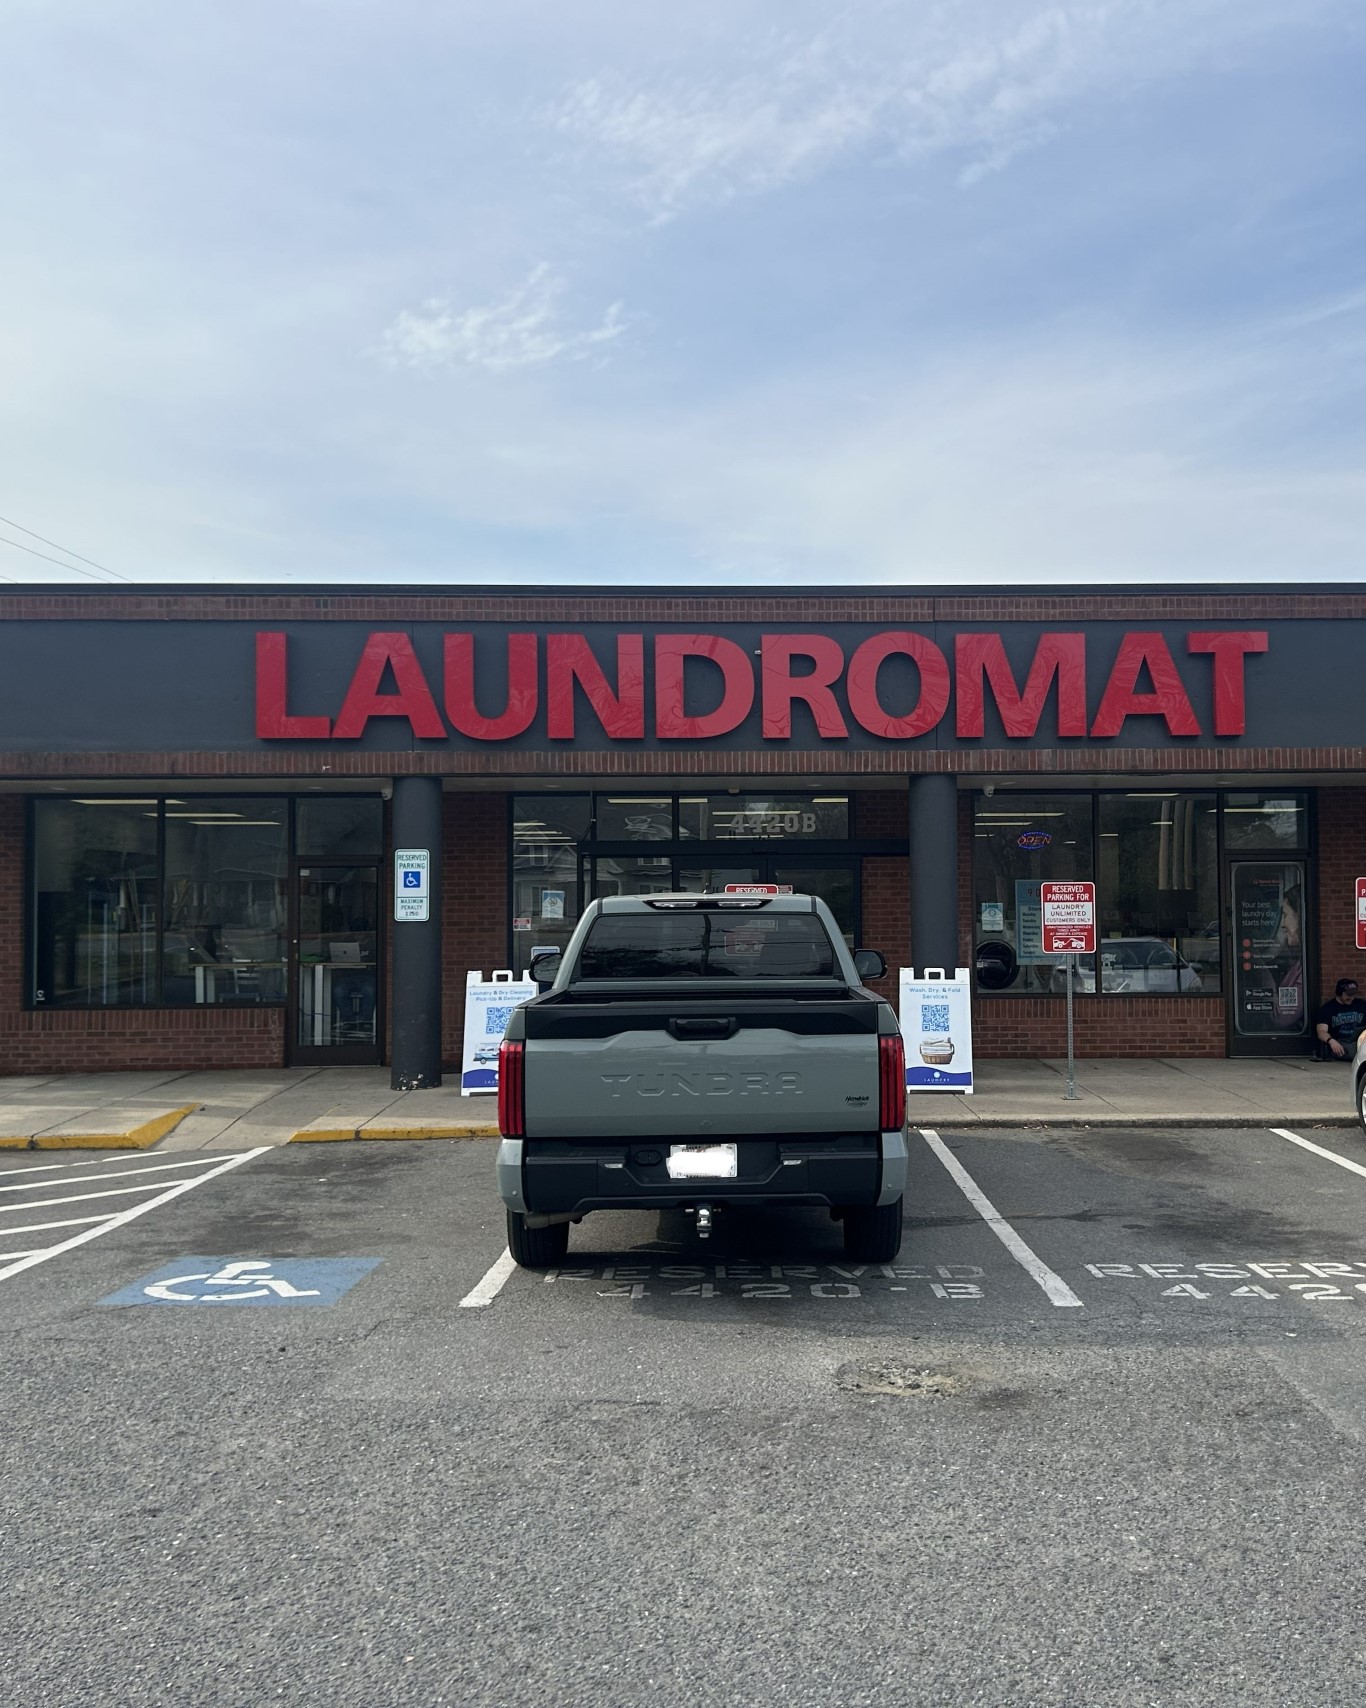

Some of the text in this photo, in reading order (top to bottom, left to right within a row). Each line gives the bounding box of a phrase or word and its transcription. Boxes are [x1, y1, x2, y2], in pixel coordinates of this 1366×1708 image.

[255, 631, 1270, 740] LAUNDROMAT
[730, 812, 816, 833] 4420B
[1017, 835, 1051, 845] OPEN
[1051, 885, 1084, 893] RESERVED
[1047, 893, 1074, 901] PARKING
[1242, 910, 1277, 918] laundry day
[600, 1072, 803, 1097] TUNDRA
[543, 1264, 985, 1283] RESERVED
